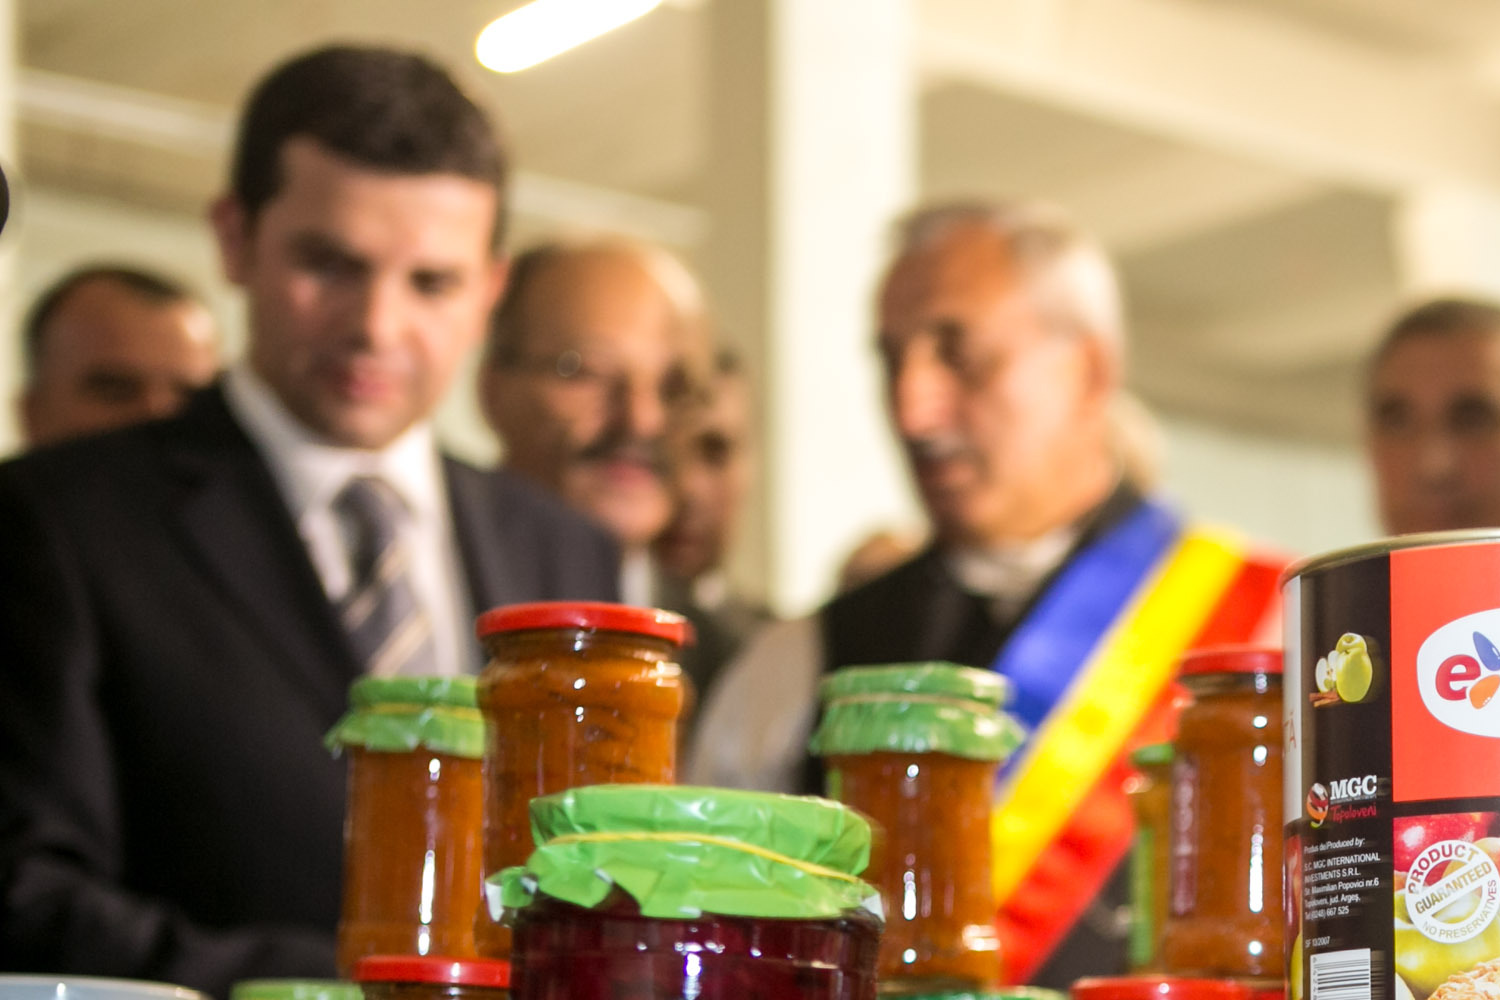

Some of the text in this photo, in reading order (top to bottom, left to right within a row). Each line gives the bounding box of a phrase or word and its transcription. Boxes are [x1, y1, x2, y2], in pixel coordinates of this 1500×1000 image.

[1330, 774, 1377, 800] MGC
[1326, 852, 1380, 867] INTERNATIONAL
[1408, 843, 1479, 895] PRODUCT
[1338, 879, 1365, 890] Popovici
[1415, 861, 1492, 914] GUARANTEED
[1422, 880, 1497, 939] NO PRESERVATIVES
